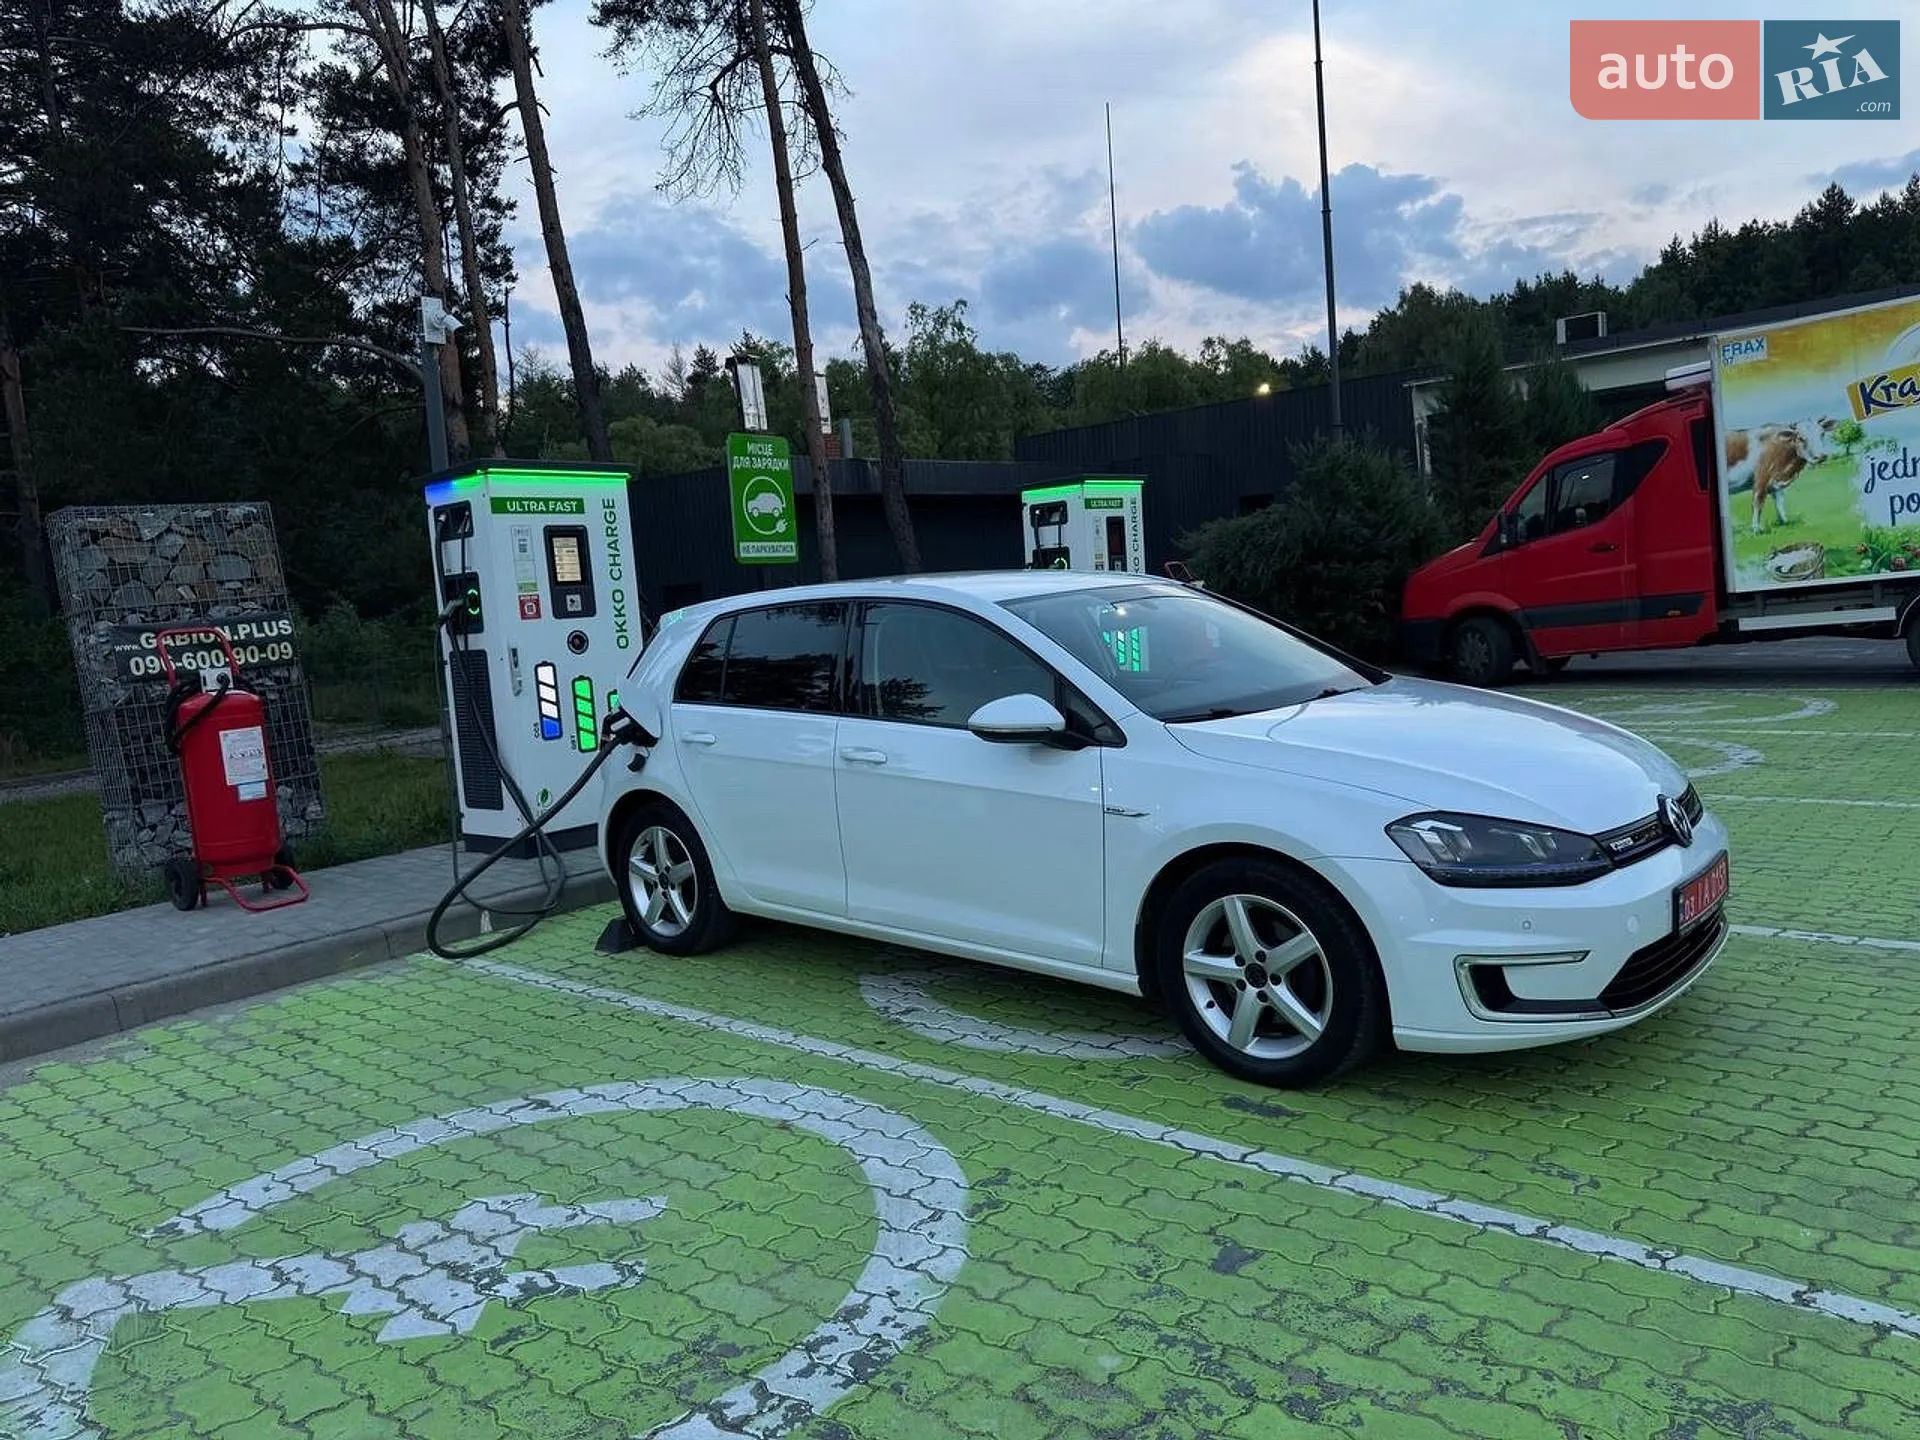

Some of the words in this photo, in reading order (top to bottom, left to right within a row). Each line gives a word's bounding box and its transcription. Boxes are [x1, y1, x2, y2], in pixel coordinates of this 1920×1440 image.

[1722, 336, 1765, 357] FRAX
[1859, 375, 1920, 416] Kra
[733, 456, 751, 469] ДЛЯ
[752, 457, 789, 471] ЗАРЯДКИ
[507, 501, 546, 512] ULTRA
[549, 501, 577, 512] FAST
[1130, 497, 1139, 552] CHARGE
[602, 498, 623, 581] CHARGE
[612, 590, 629, 649] OKKO
